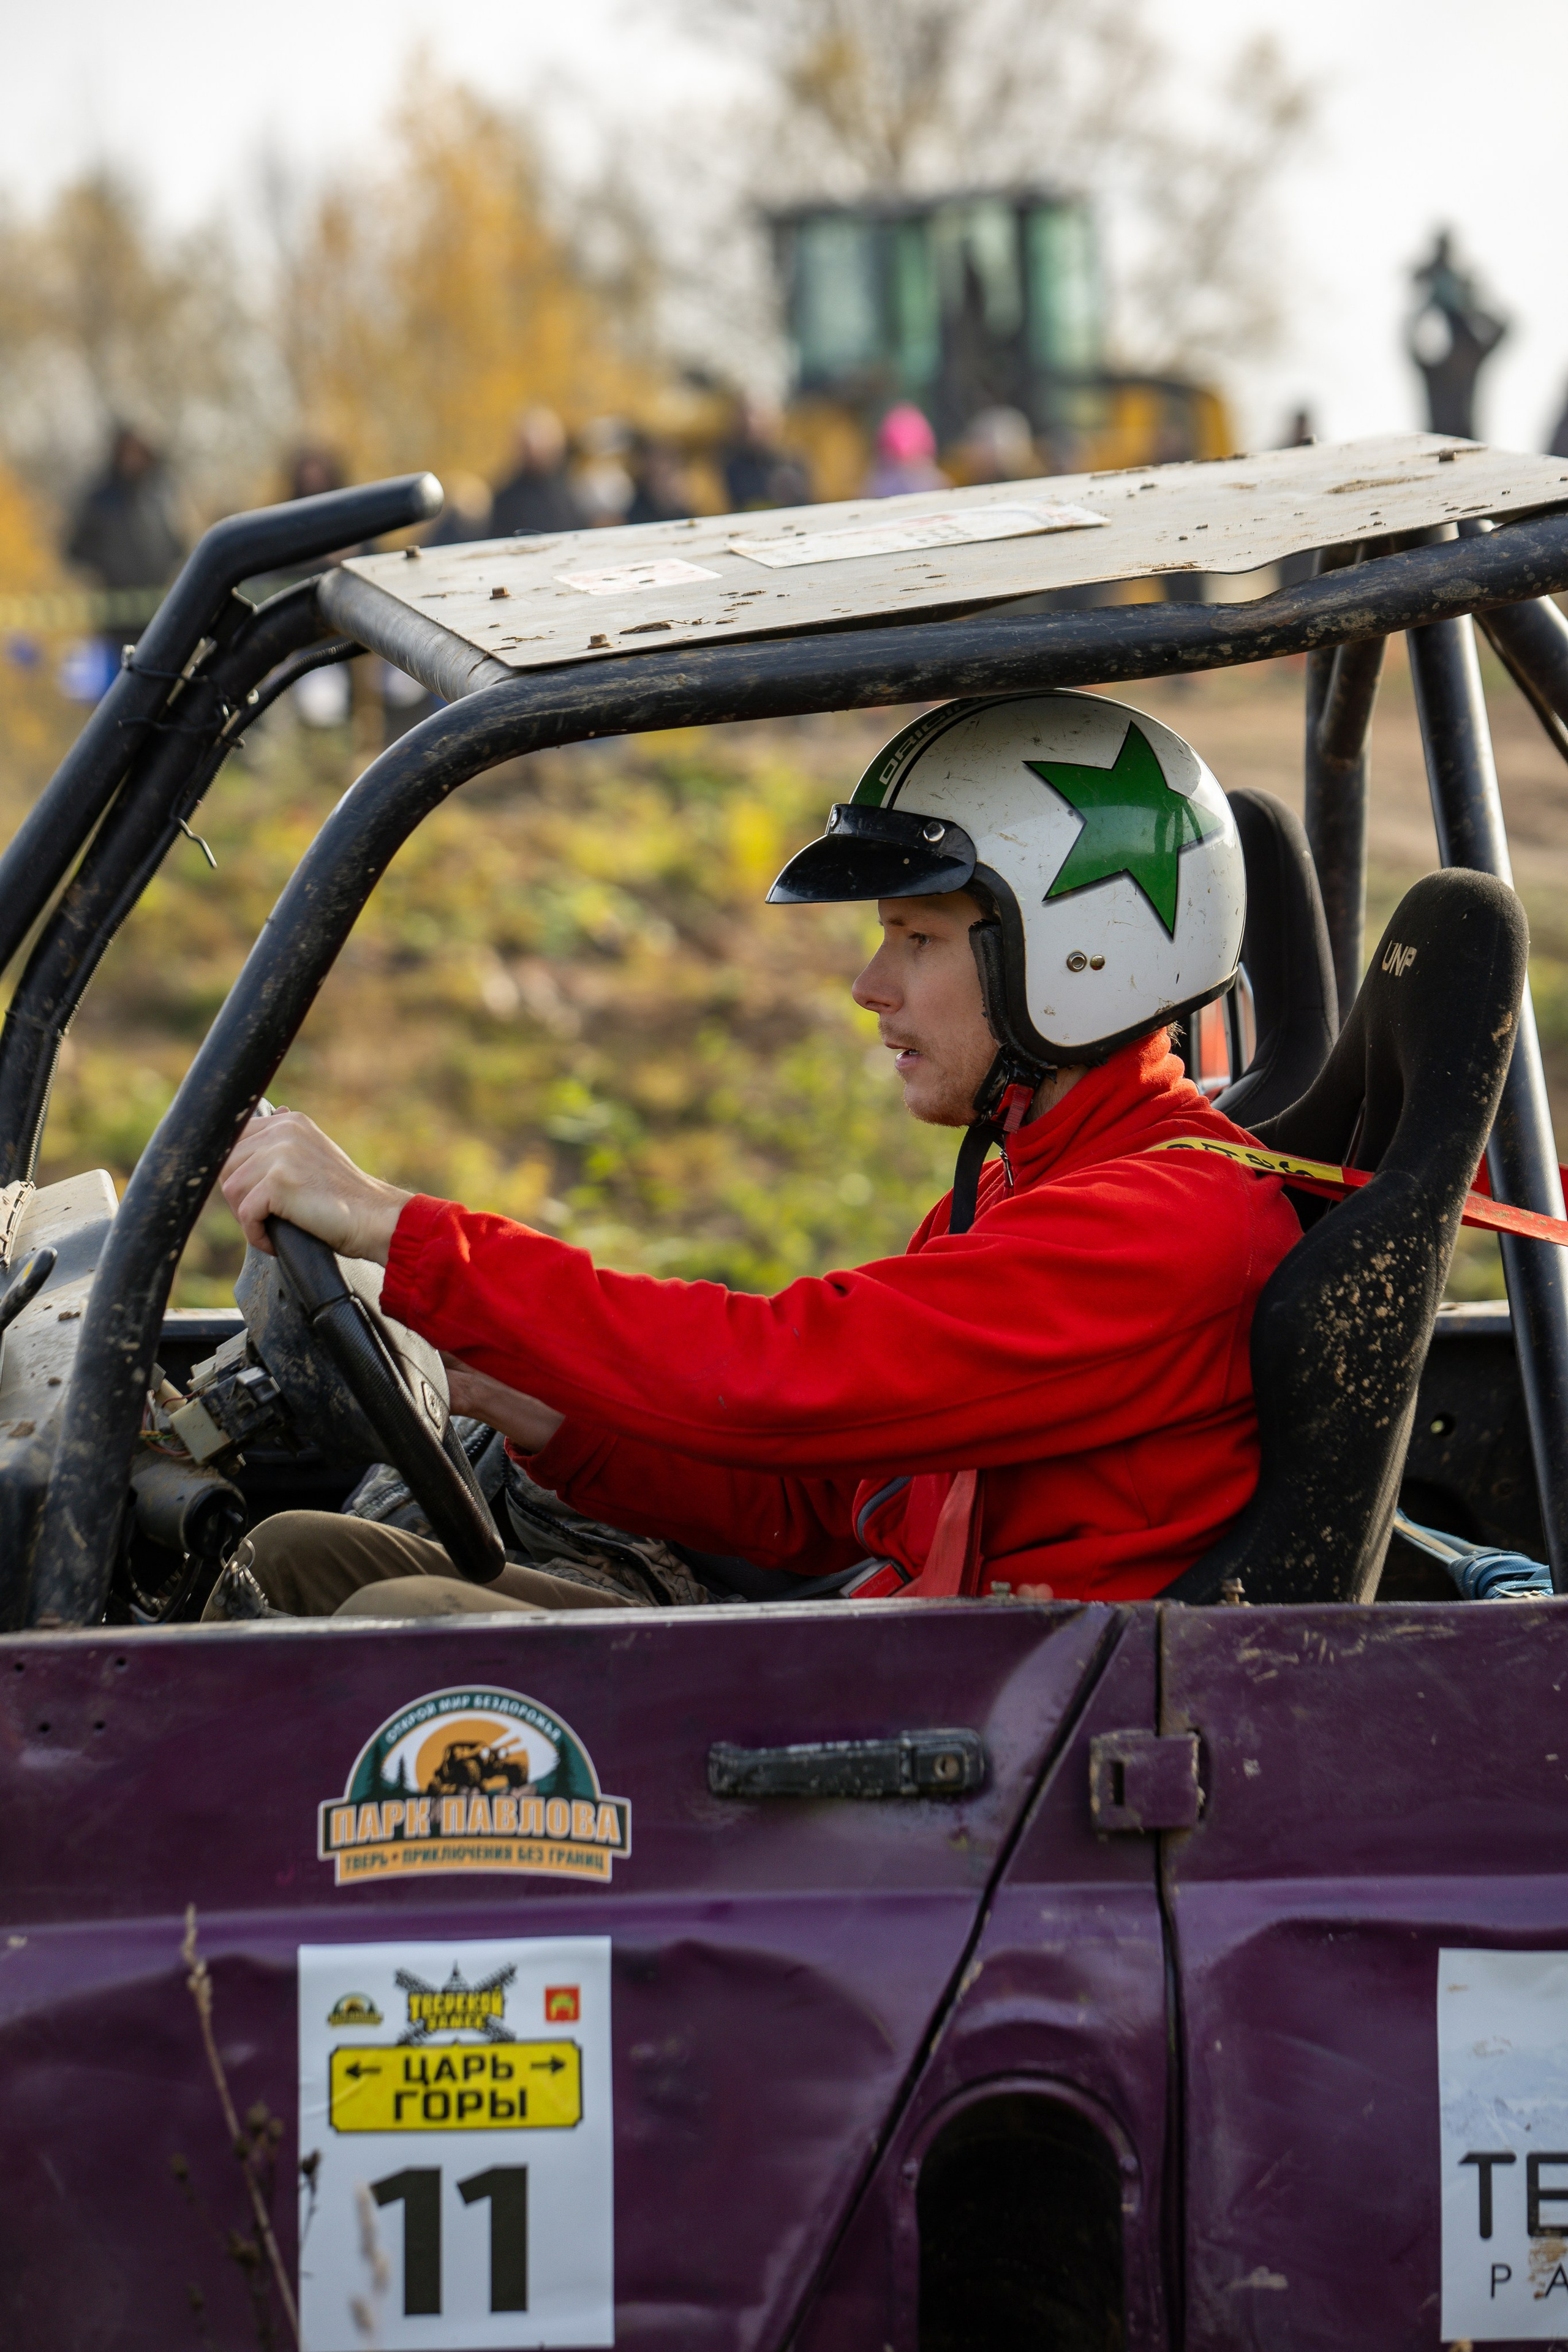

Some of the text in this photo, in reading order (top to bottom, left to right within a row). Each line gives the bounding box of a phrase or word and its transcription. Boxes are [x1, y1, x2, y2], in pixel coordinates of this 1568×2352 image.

[385, 1694, 562, 1744] ОТКРОЙ МИР БЕЗДОРОЖЬЯ
[330, 1795, 622, 1847] ПАРК ПАВЛОВА
[345, 1845, 604, 1872] ТВЕРЬ ПРИКЛЮЧЕНИЯ БЕЗ ГРАНИЦ
[403, 2054, 514, 2086] ЦАРЬ
[394, 2088, 527, 2122] ГОРЫ
[369, 2163, 529, 2316] 11
